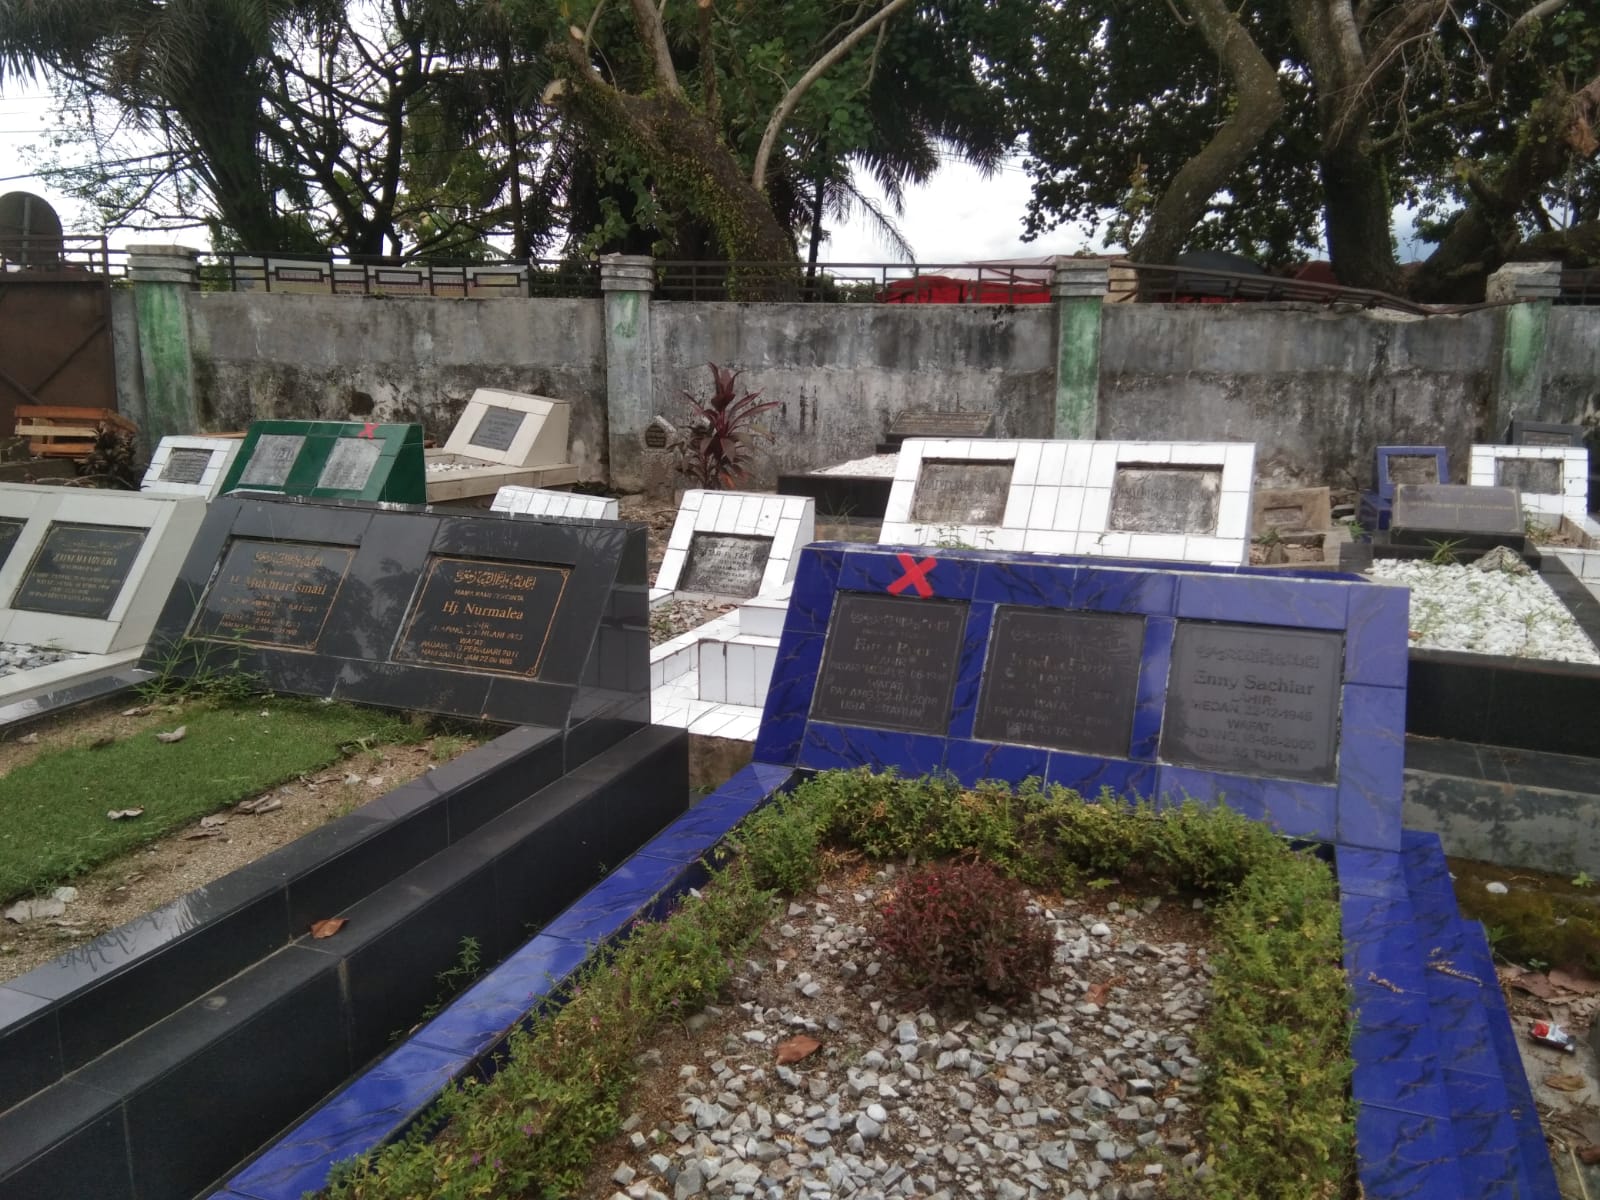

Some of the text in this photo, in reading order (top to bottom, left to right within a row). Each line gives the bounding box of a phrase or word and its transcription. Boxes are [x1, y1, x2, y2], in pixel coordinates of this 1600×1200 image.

[463, 602, 525, 620] Nurmalea
[1193, 669, 1315, 696] Enny Sachiar
